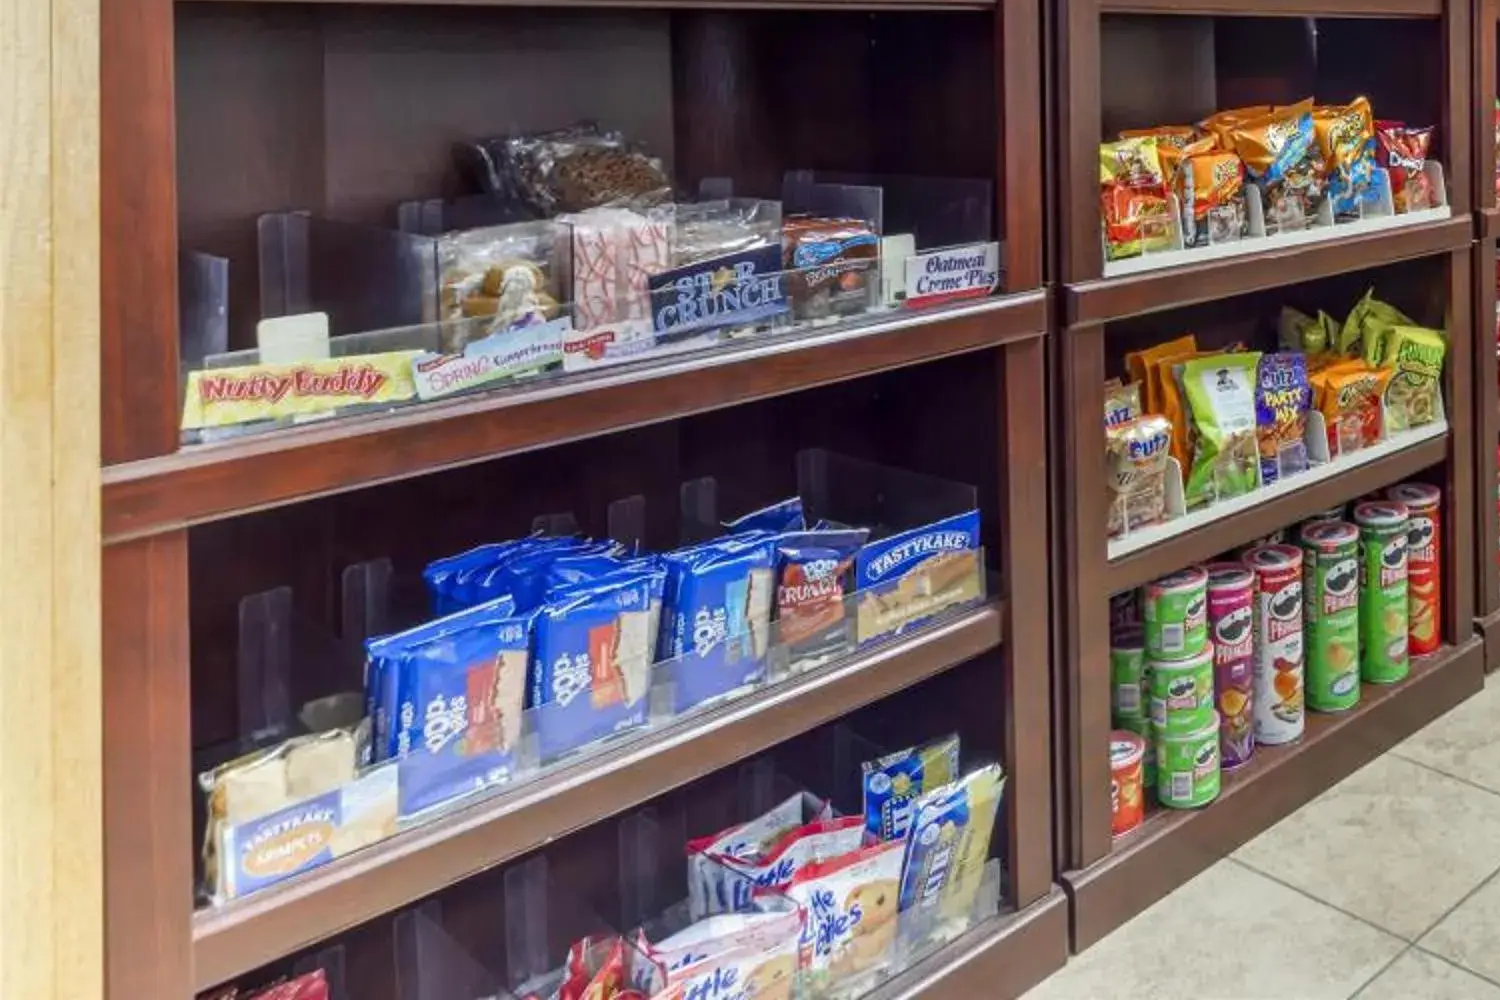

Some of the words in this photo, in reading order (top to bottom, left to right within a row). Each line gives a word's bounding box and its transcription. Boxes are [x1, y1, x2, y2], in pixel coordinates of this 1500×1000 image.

[925, 254, 986, 274] Oatmeal
[655, 274, 783, 334] CRUNCH
[916, 275, 962, 295] Creme
[200, 374, 292, 405] Nutty
[291, 364, 388, 399] Buddy
[869, 532, 967, 575] TASTYKAKE
